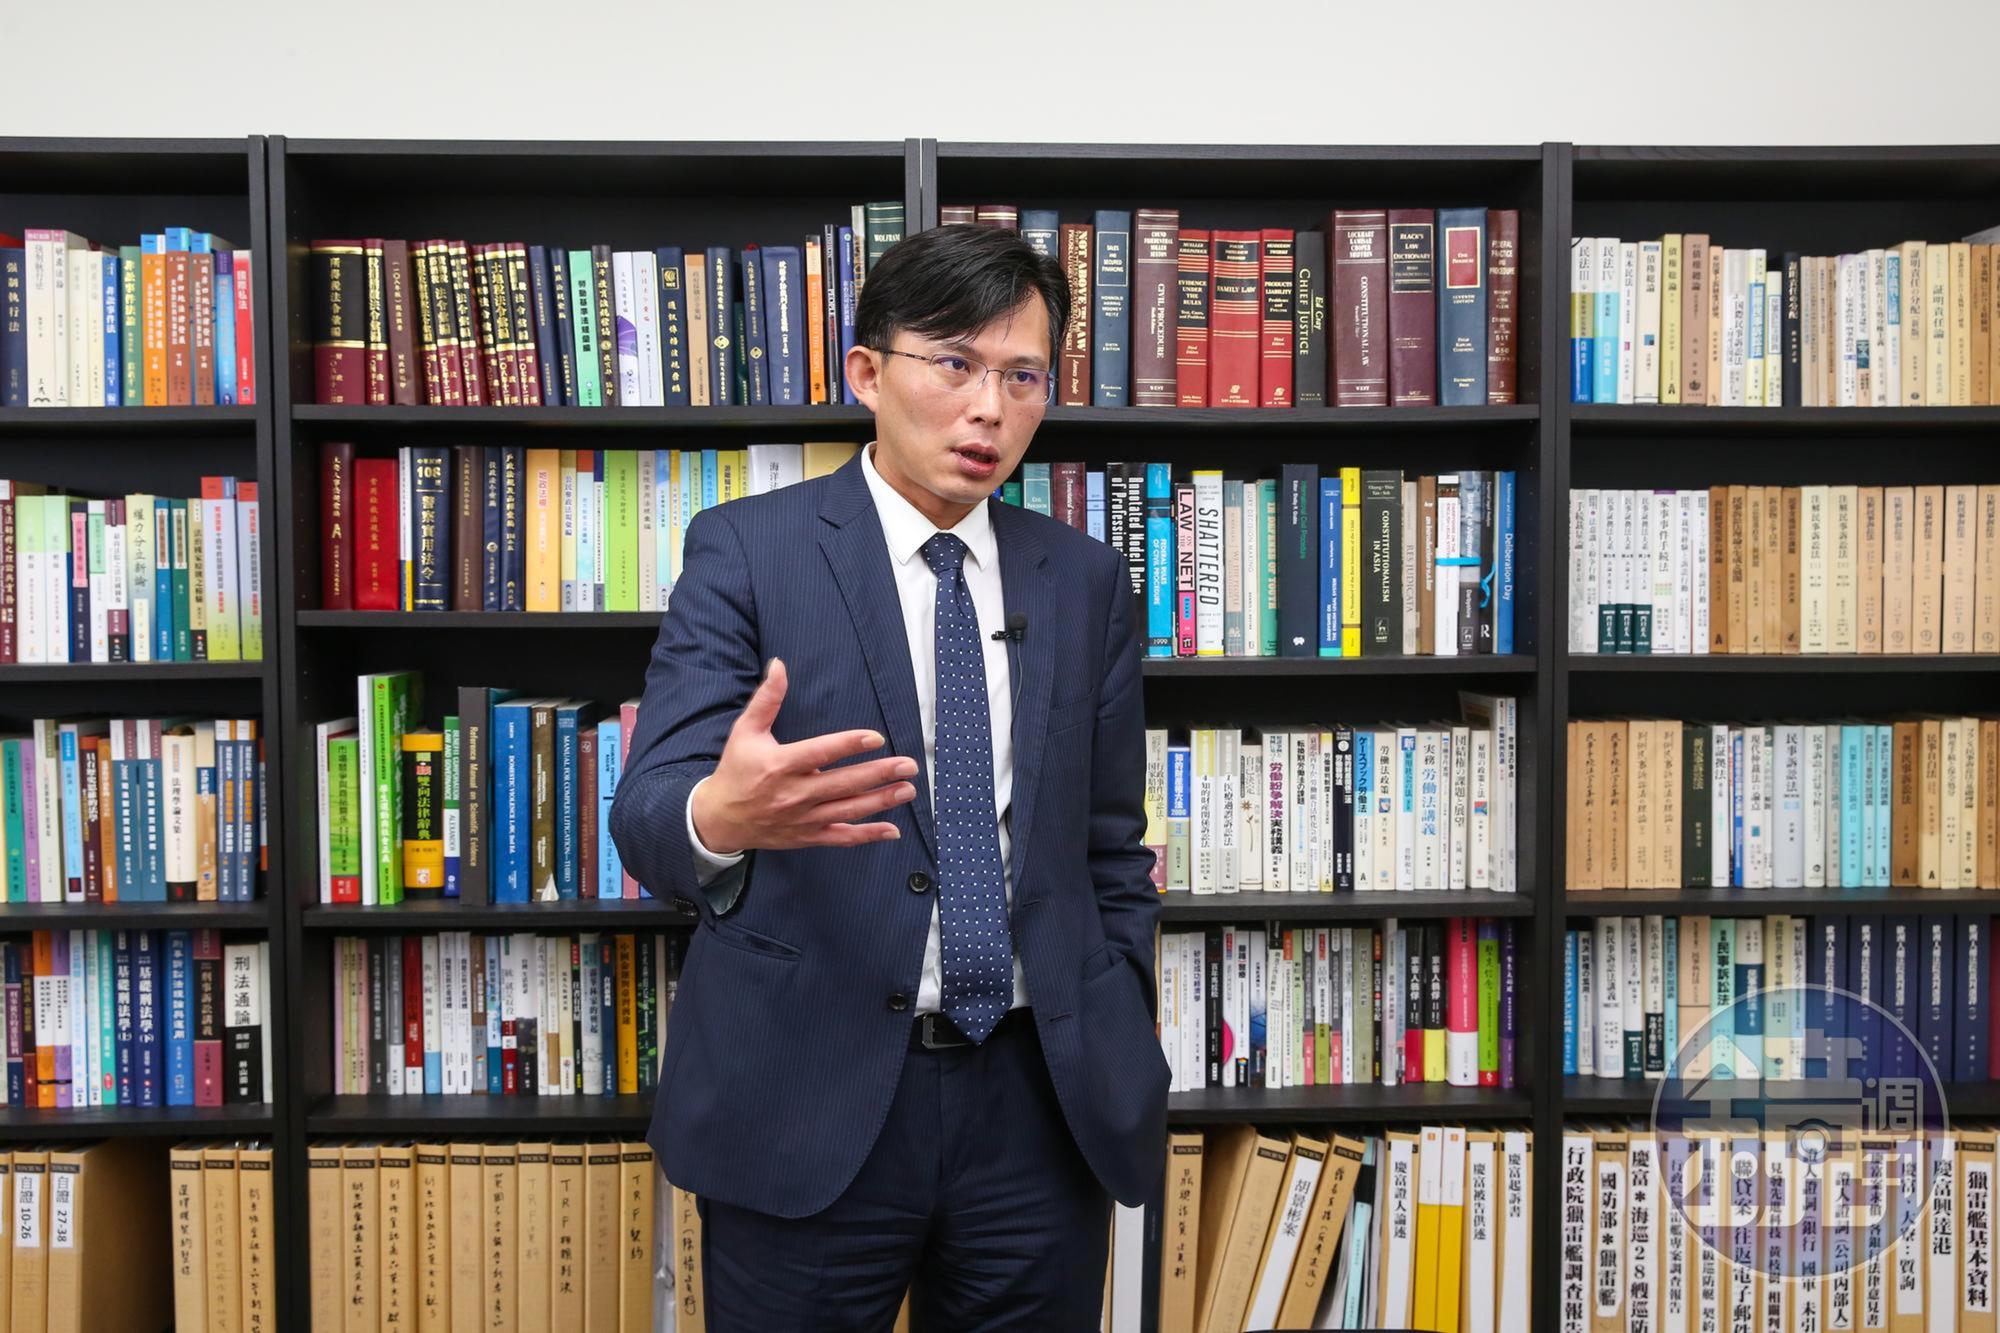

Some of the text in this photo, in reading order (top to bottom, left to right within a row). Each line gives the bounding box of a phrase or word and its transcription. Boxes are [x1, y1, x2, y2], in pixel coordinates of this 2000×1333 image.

[1078, 230, 1087, 258] NOT
[1078, 260, 1087, 304] ABOVE
[1299, 268, 1310, 355] CHIEF JUSTICE
[1314, 296, 1324, 330] Ed Cray
[1359, 276, 1368, 349] CONSTITUTIONAL
[1909, 250, 1921, 314] 証明責任の分配
[1933, 284, 1945, 339] 証明責任論
[1078, 321, 1087, 352] LAW
[1157, 283, 1165, 358] CIVIL PROCEDURE
[416, 466, 442, 478] 108
[421, 495, 435, 580] 警察實用法令
[1128, 477, 1146, 595] Annotated Model Rules
[1179, 491, 1193, 588] LAW NET
[1199, 507, 1219, 606] SHATTERED
[1373, 540, 1381, 573] IN ASIA
[1382, 510, 1390, 603] CONSTITUTIONALISM
[1503, 533, 1513, 601] Deliberation Day
[1658, 498, 1671, 573] 家事事件手続法
[1405, 544, 1415, 613] RES JUDICATA
[1465, 589, 1473, 618] Darbyshire
[1357, 737, 1368, 814] ケースブック労働法
[1379, 746, 1390, 795] 労働法政策
[1714, 734, 1727, 780] 新証拠法
[1785, 732, 1798, 793] 民事訴訟法
[416, 775, 432, 841] 雙向法律辭典
[469, 726, 479, 867] Reference Manual on Scientific Evidence
[233, 956, 250, 1025] 刑法通論
[1716, 942, 1730, 1006] 民事訴訟法
[1508, 1153, 1521, 1218] 慶富起訴書
[1932, 1159, 1953, 1255] 慶富興達港
[21, 1207, 32, 1240] 10-26
[57, 1209, 68, 1243] 27-38
[1966, 1170, 1989, 1308] 獵雷艦基本資料
